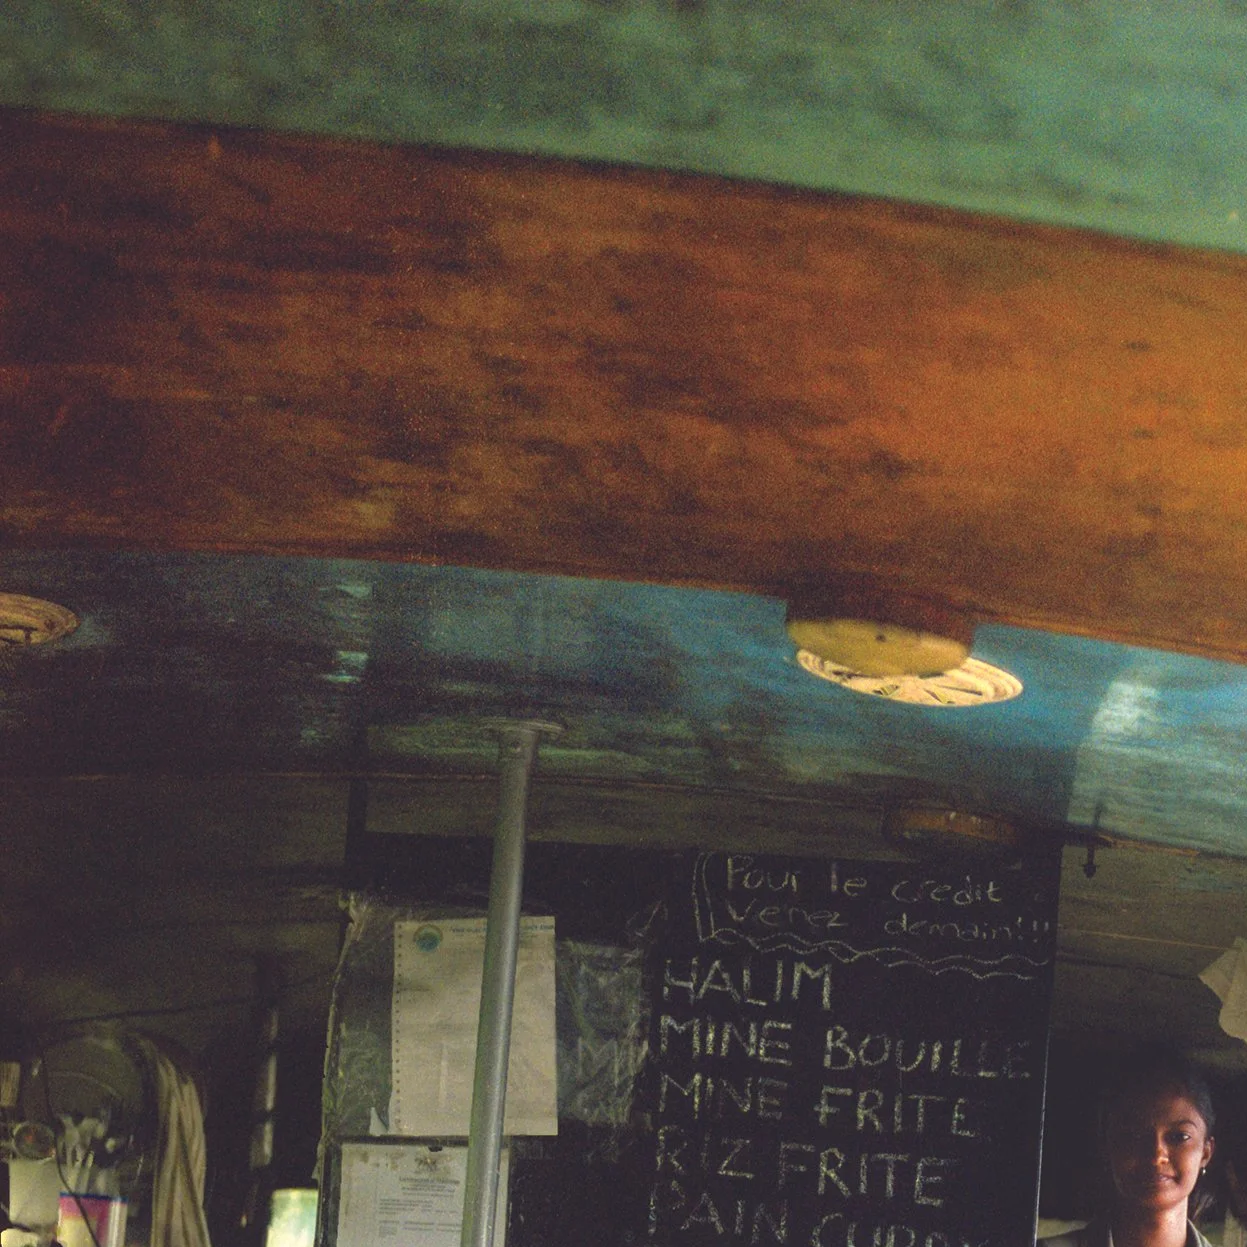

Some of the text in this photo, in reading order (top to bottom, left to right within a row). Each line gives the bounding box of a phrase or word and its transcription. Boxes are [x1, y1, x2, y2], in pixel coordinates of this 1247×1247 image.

[727, 855, 798, 891] Pour
[831, 862, 867, 897] le
[663, 957, 831, 1010] HALIM
[660, 1015, 1030, 1079] MINE BOUILLE
[660, 1071, 979, 1138] MINE FRITE
[657, 1124, 957, 1208] RIZ FRITE
[648, 1179, 788, 1245] PAIN
